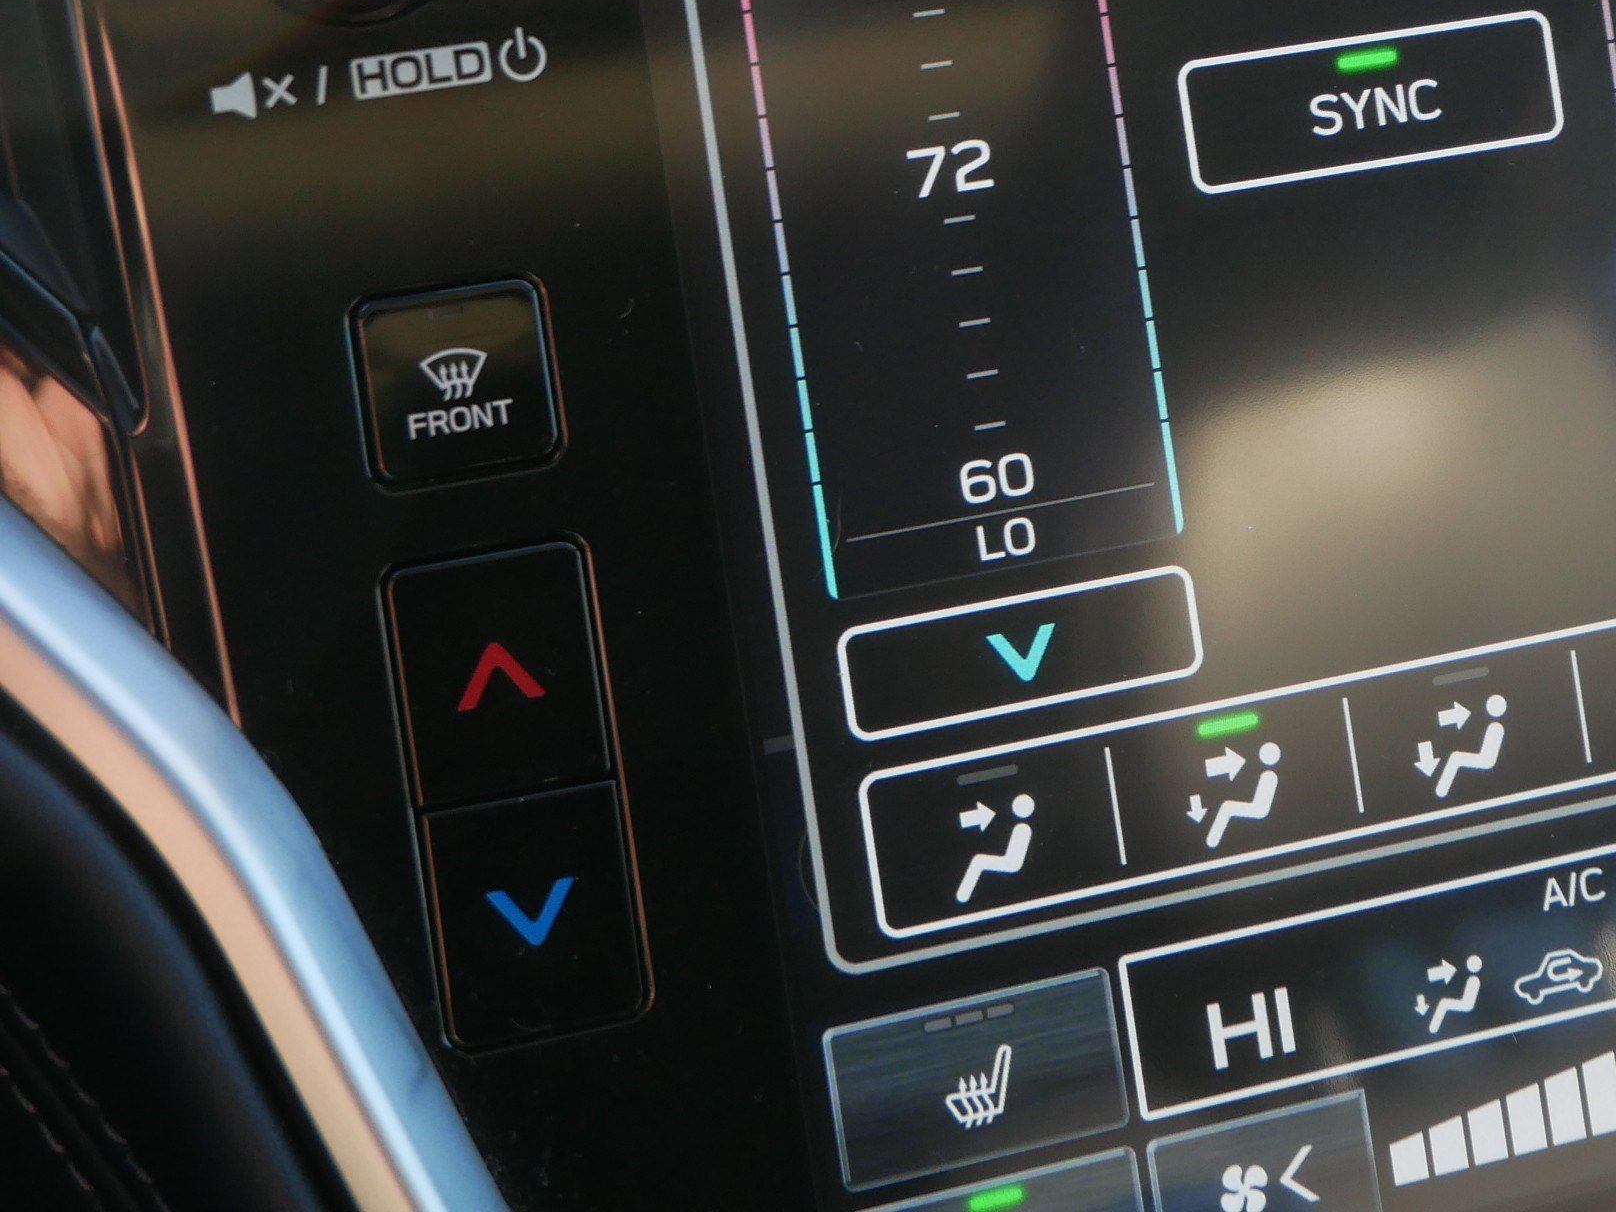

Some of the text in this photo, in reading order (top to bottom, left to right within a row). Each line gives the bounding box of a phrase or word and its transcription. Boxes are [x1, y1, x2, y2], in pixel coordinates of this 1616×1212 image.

[356, 49, 484, 95] HOLD
[1309, 78, 1442, 136] SYNC
[906, 139, 995, 198] 72
[407, 398, 513, 440] FRONT
[959, 452, 1035, 504] 60
[976, 517, 1036, 562] LO
[1542, 868, 1607, 912] A/C
[1206, 986, 1297, 1070] HI
